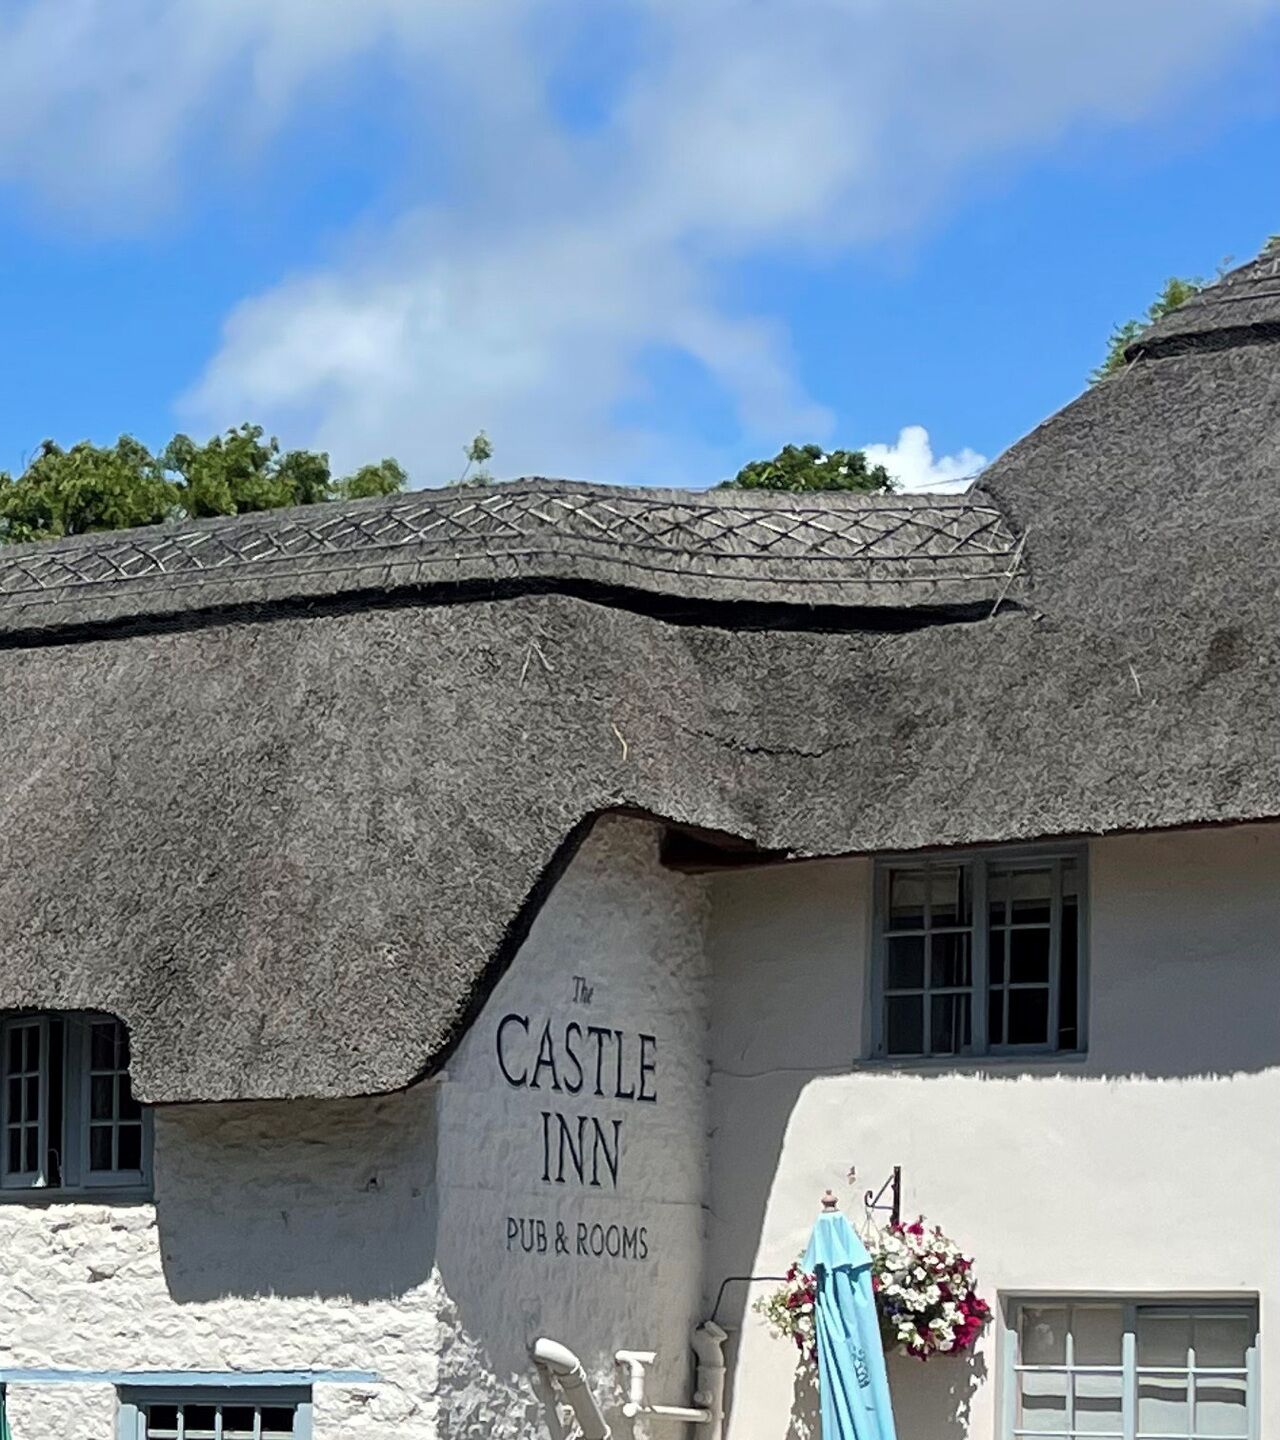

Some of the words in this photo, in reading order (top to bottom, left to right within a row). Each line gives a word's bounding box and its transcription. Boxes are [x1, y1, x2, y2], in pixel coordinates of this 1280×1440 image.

[572, 975, 595, 1004] The
[496, 1013, 658, 1102] CASTLE
[540, 1111, 623, 1188] INN
[506, 1217, 548, 1252] PUB
[555, 1220, 570, 1255] &
[576, 1222, 649, 1260] ROOMS
